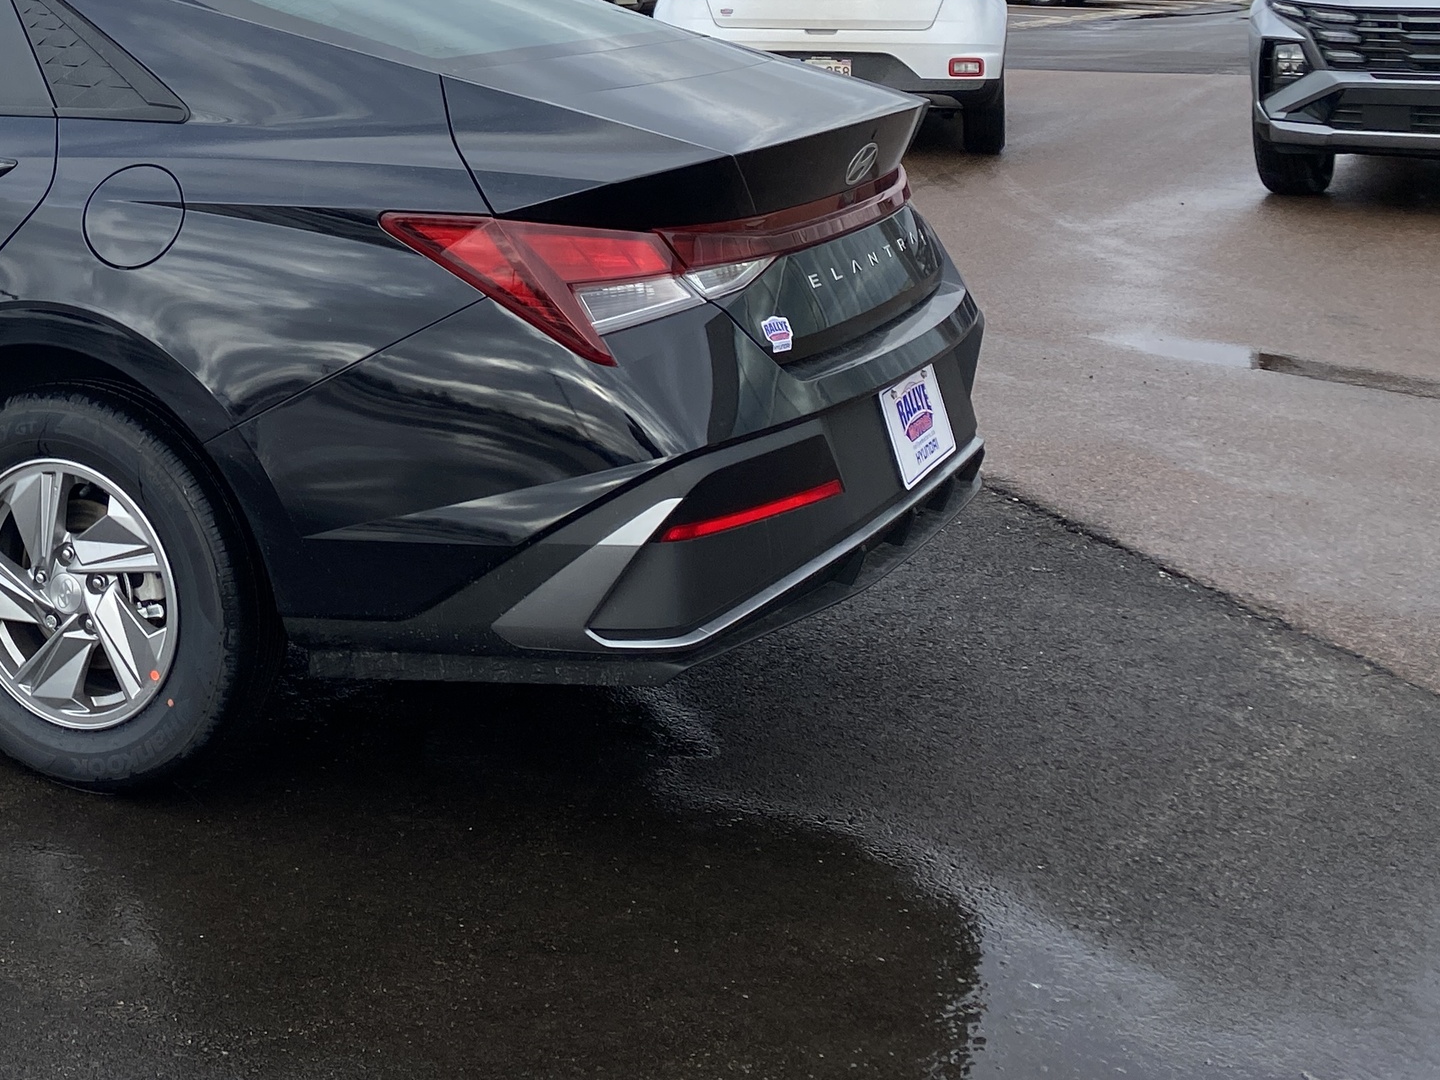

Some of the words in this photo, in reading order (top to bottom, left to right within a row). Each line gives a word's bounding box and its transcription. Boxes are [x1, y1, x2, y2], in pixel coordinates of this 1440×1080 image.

[808, 231, 918, 289] ELANTRA
[764, 321, 790, 337] RALLYE
[896, 383, 932, 432] RALLYE
